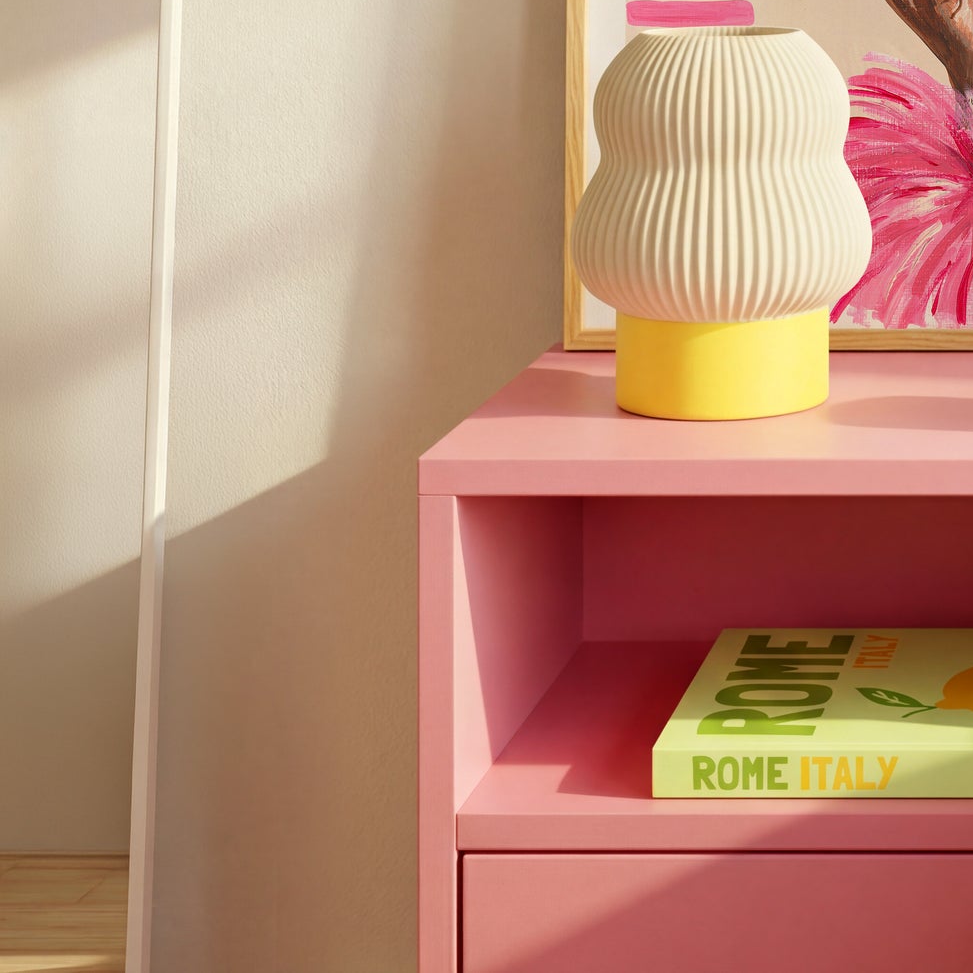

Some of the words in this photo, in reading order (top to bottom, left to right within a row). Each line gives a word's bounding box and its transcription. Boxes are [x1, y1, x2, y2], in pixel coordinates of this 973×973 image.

[853, 634, 899, 669] ITALY
[697, 634, 855, 735] ROME
[691, 755, 789, 791] ROME
[800, 756, 899, 790] ITALY
